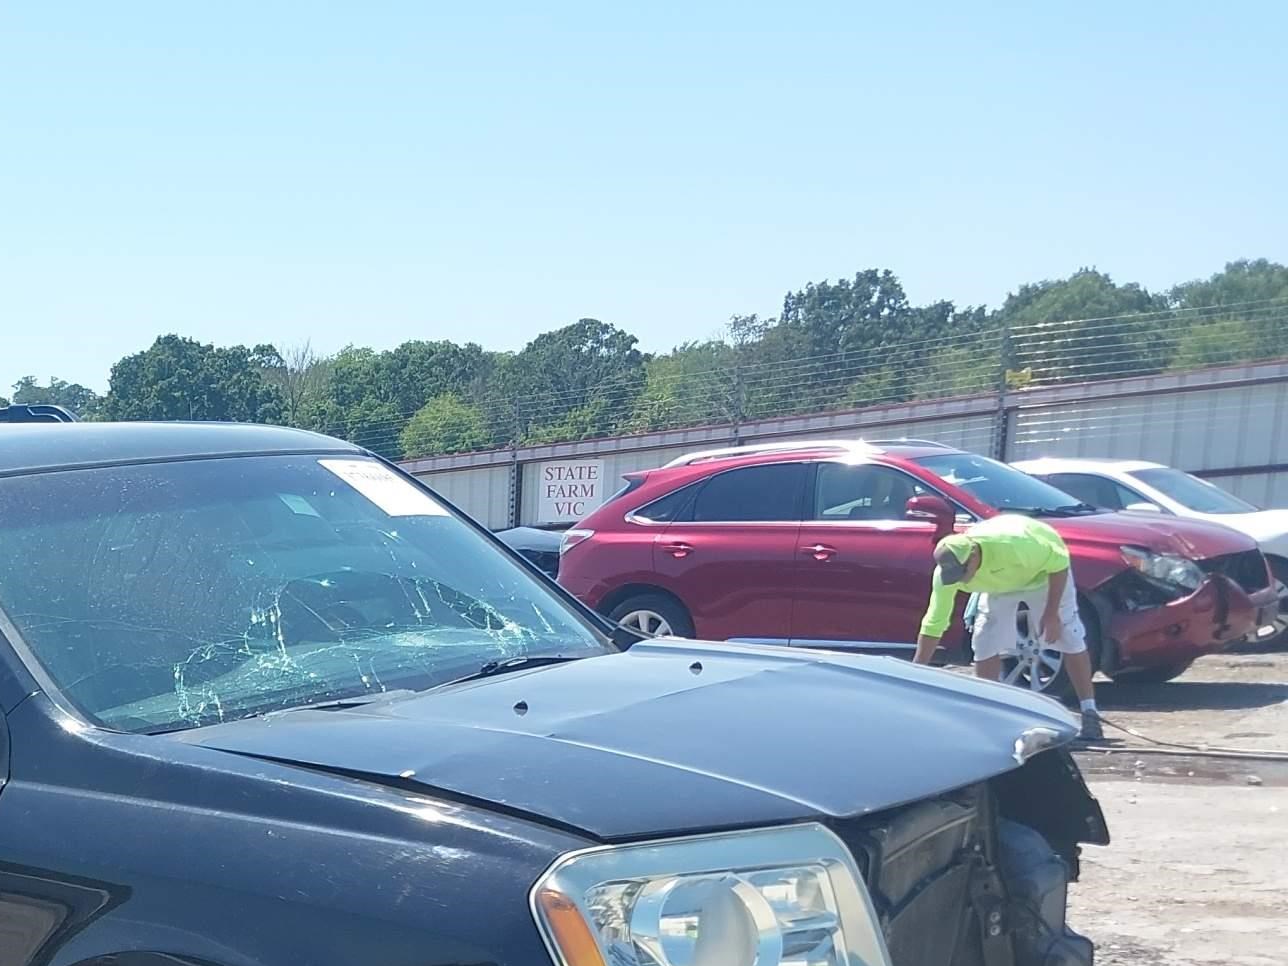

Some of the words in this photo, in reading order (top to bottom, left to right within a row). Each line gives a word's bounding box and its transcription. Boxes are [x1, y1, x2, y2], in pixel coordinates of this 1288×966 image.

[544, 465, 598, 481] STATE
[546, 484, 594, 498] FARM
[554, 501, 585, 516] VIC
